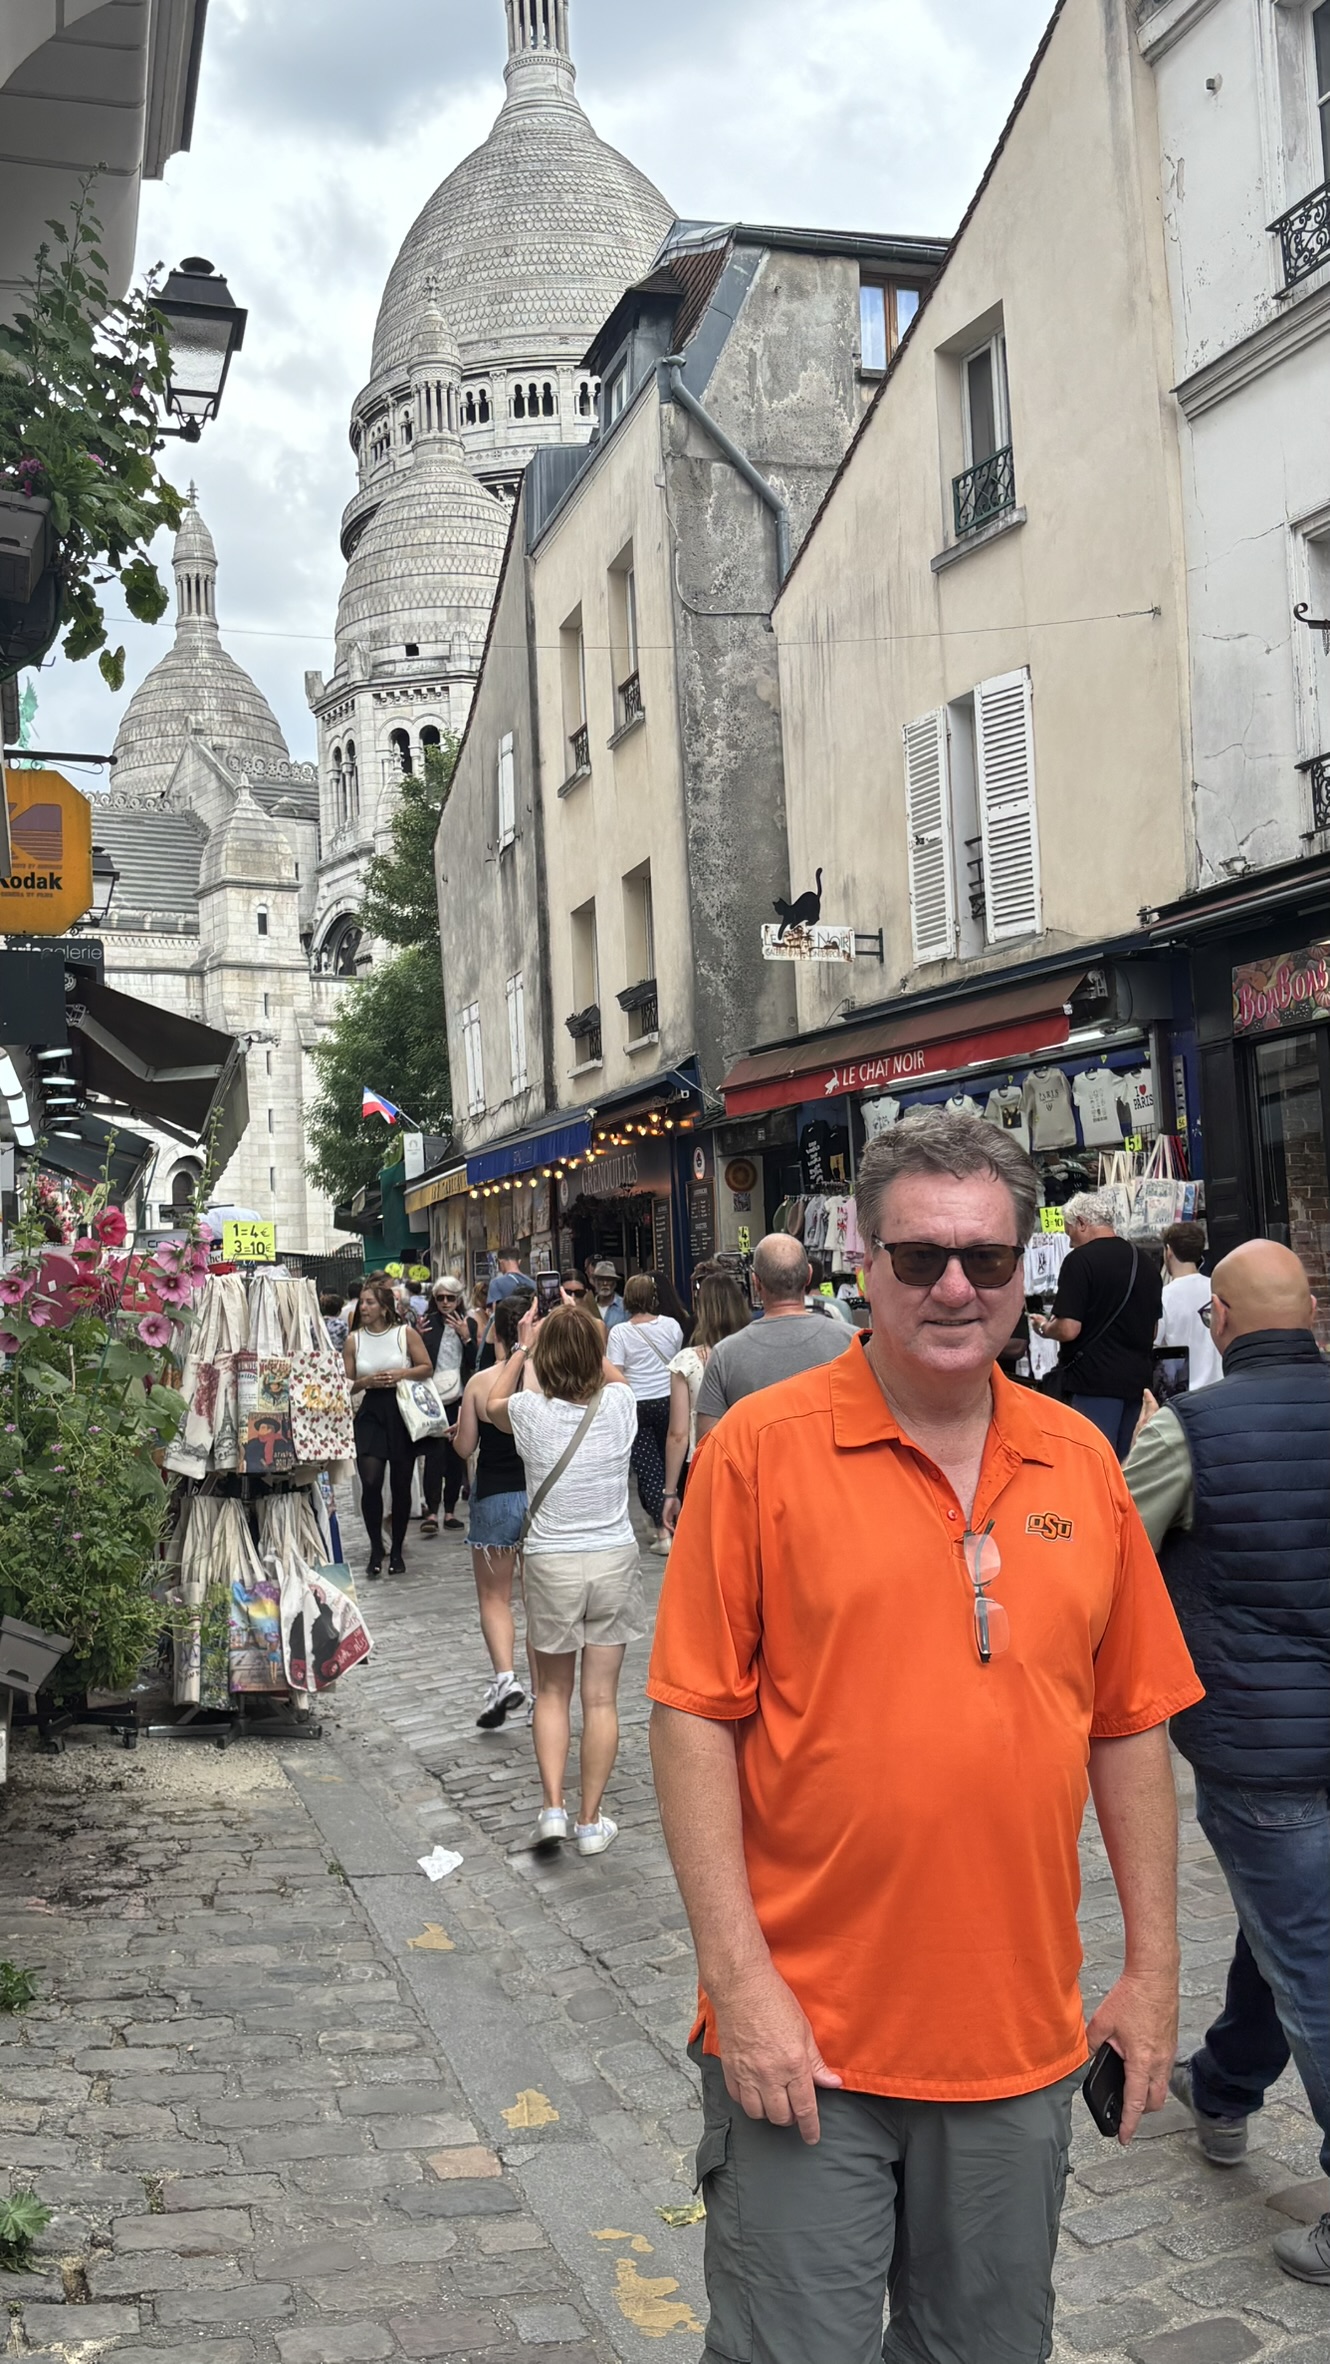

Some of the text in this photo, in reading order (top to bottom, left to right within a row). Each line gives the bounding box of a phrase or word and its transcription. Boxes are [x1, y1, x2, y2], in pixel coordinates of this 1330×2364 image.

[843, 1050, 925, 1086] LE CHAT NOIR
[1133, 1094, 1154, 1110] PARIS
[1134, 1086, 1140, 1096] I
[581, 1152, 638, 1196] GRENOUILLES
[1027, 1512, 1073, 1541] OSU
